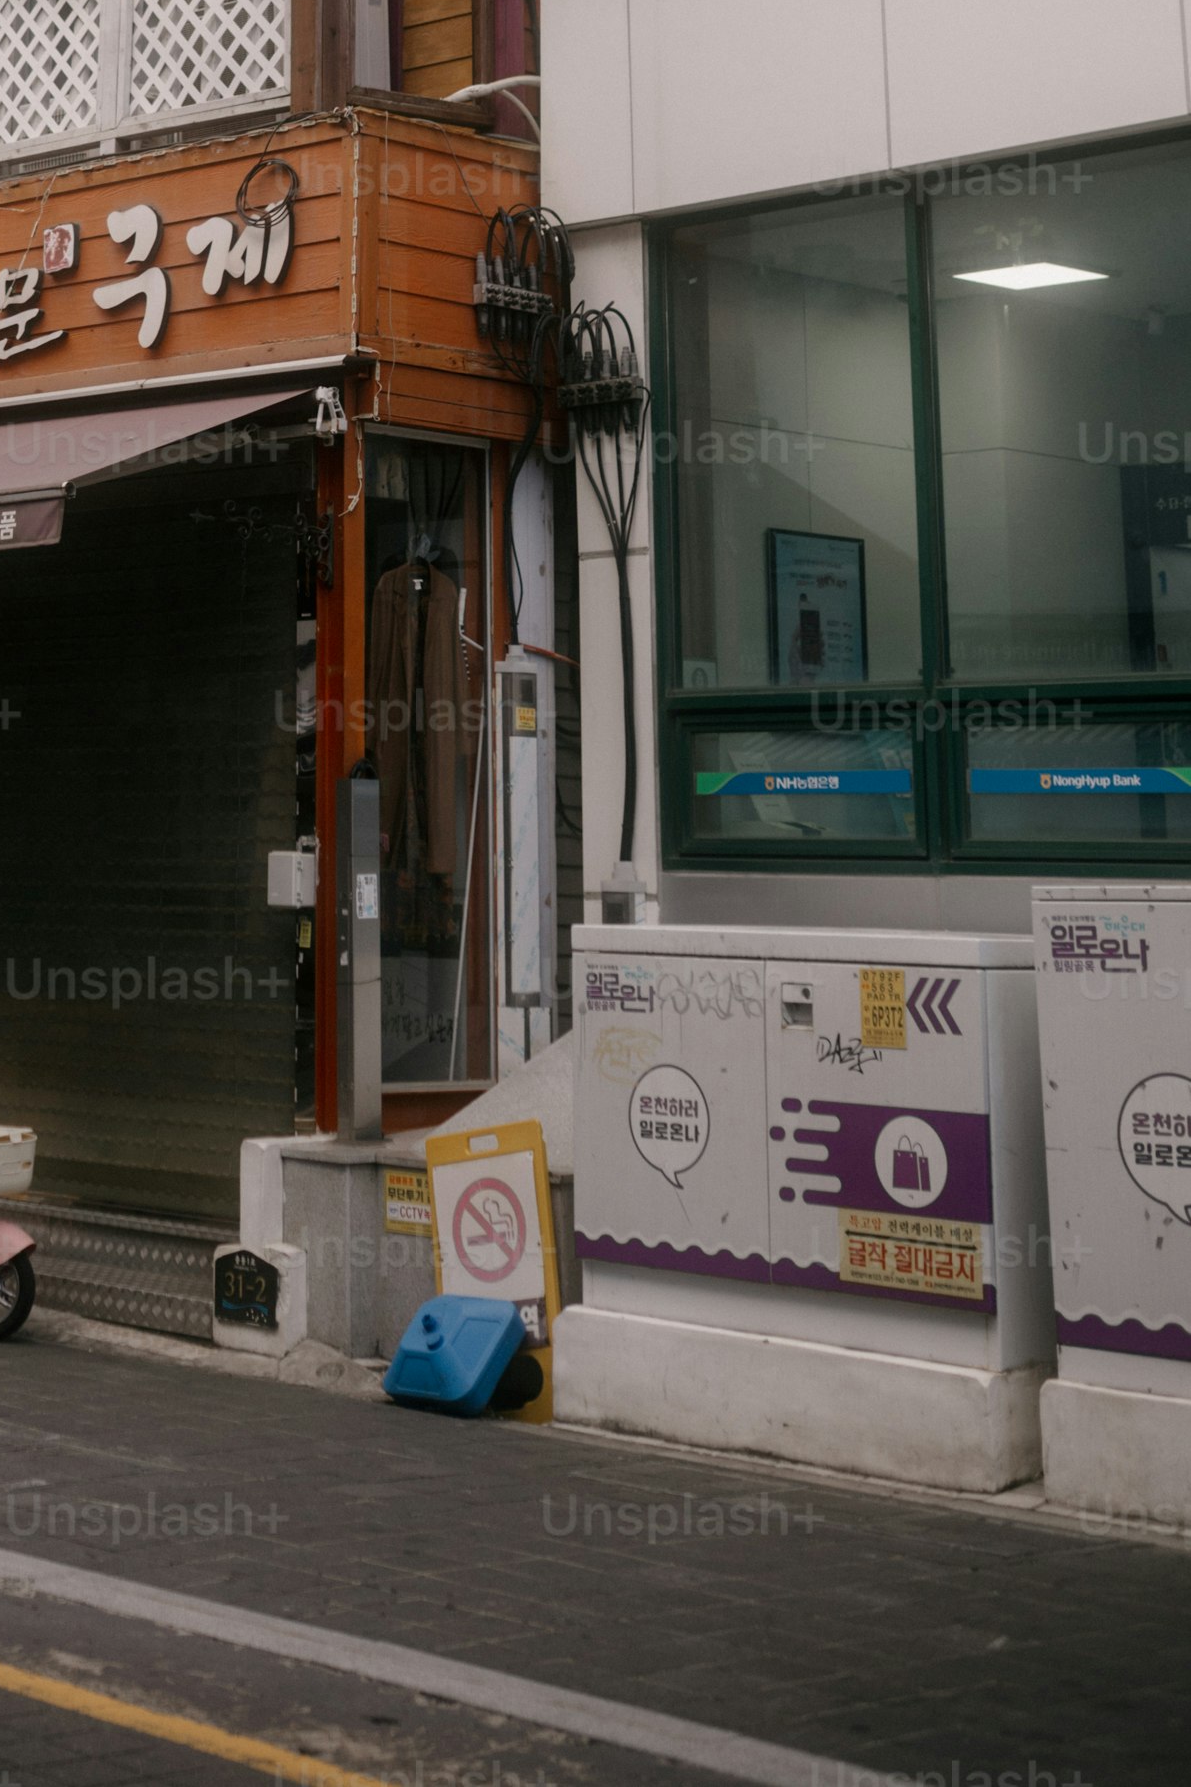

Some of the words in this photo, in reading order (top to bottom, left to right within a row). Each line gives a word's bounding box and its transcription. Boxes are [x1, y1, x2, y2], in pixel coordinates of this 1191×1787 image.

[1053, 774, 1110, 789] NongHyup
[1113, 774, 1141, 787] Bank
[639, 1096, 699, 1118] 온천하러
[639, 1120, 700, 1144] 일로온나
[388, 1187, 424, 1203] 무단투기
[849, 1214, 881, 1231] 특고압
[888, 1220, 945, 1239] 전력케이블
[950, 1228, 973, 1242] 매설
[848, 1238, 888, 1271] 굴착
[894, 1244, 975, 1283] 절대금지
[224, 1271, 267, 1303] 31-2
